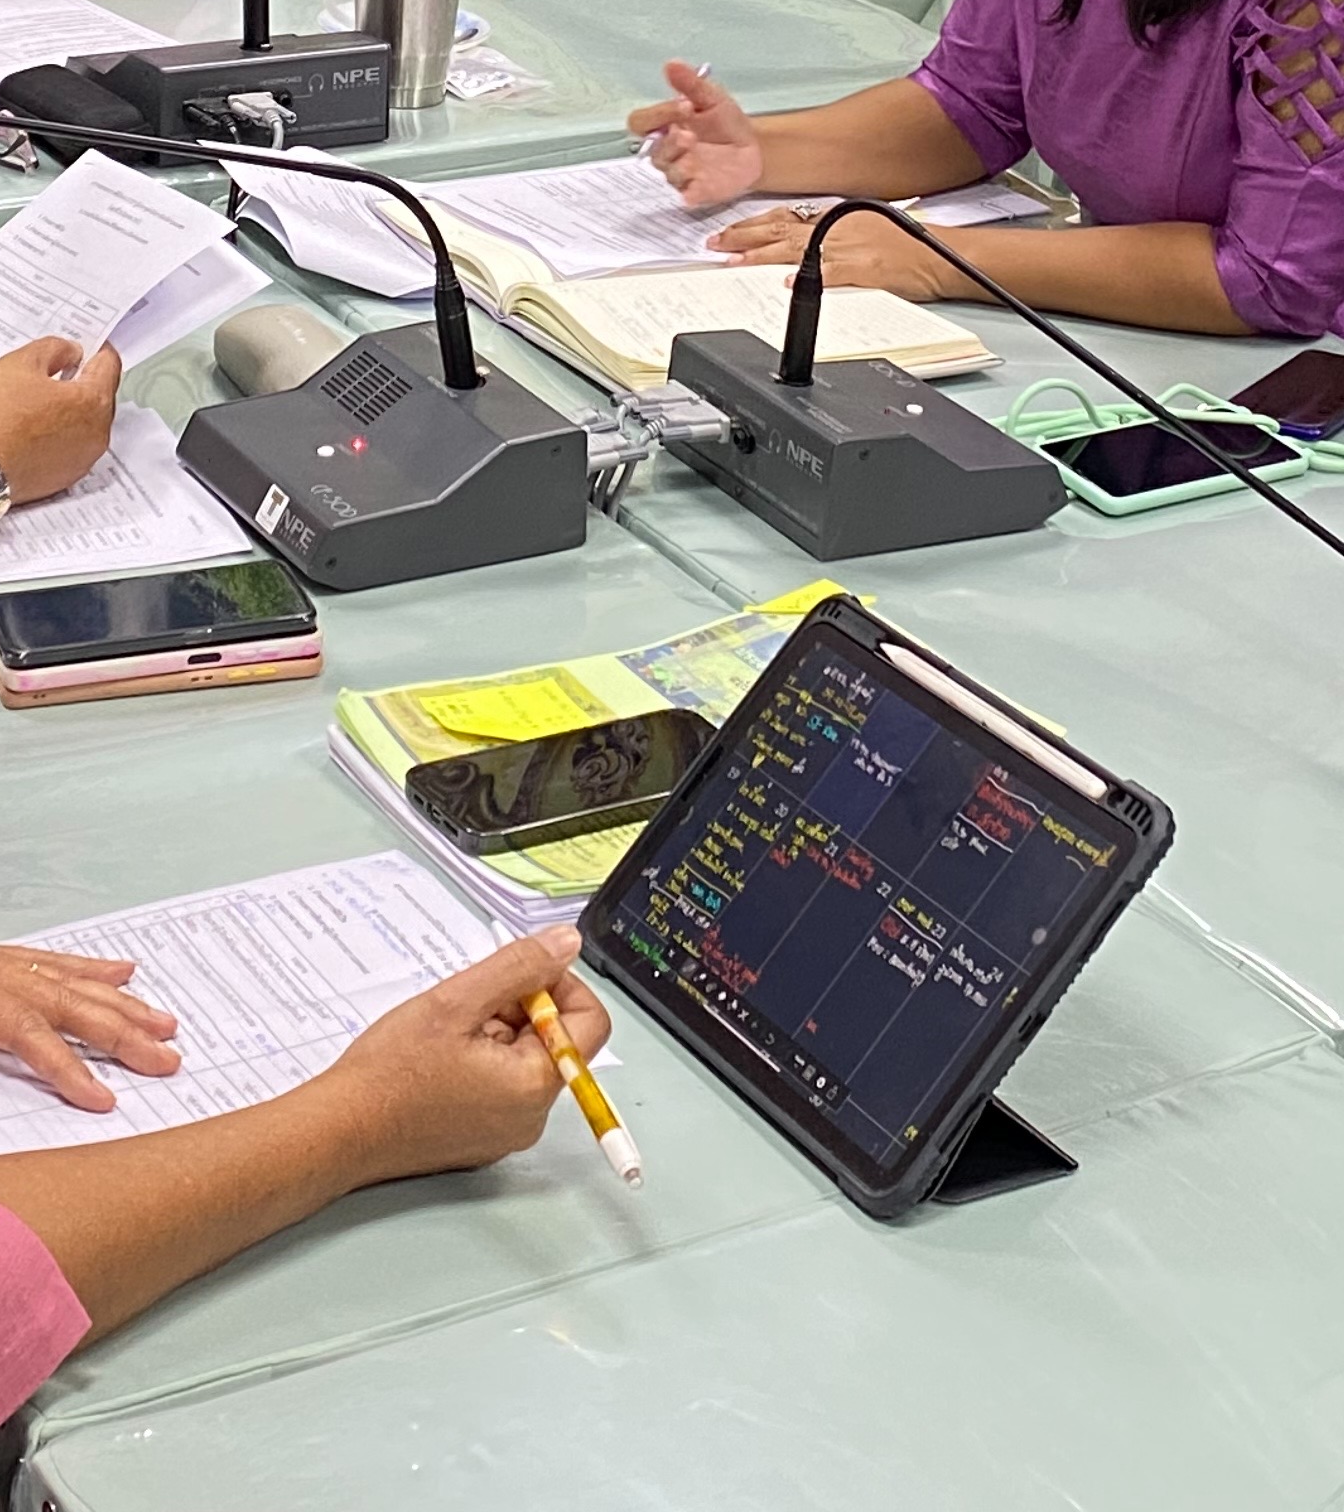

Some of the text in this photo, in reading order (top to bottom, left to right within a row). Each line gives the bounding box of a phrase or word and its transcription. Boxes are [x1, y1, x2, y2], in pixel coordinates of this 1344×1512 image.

[332, 66, 380, 84] NPE
[785, 439, 824, 475] NPE
[279, 508, 316, 550] NPE
